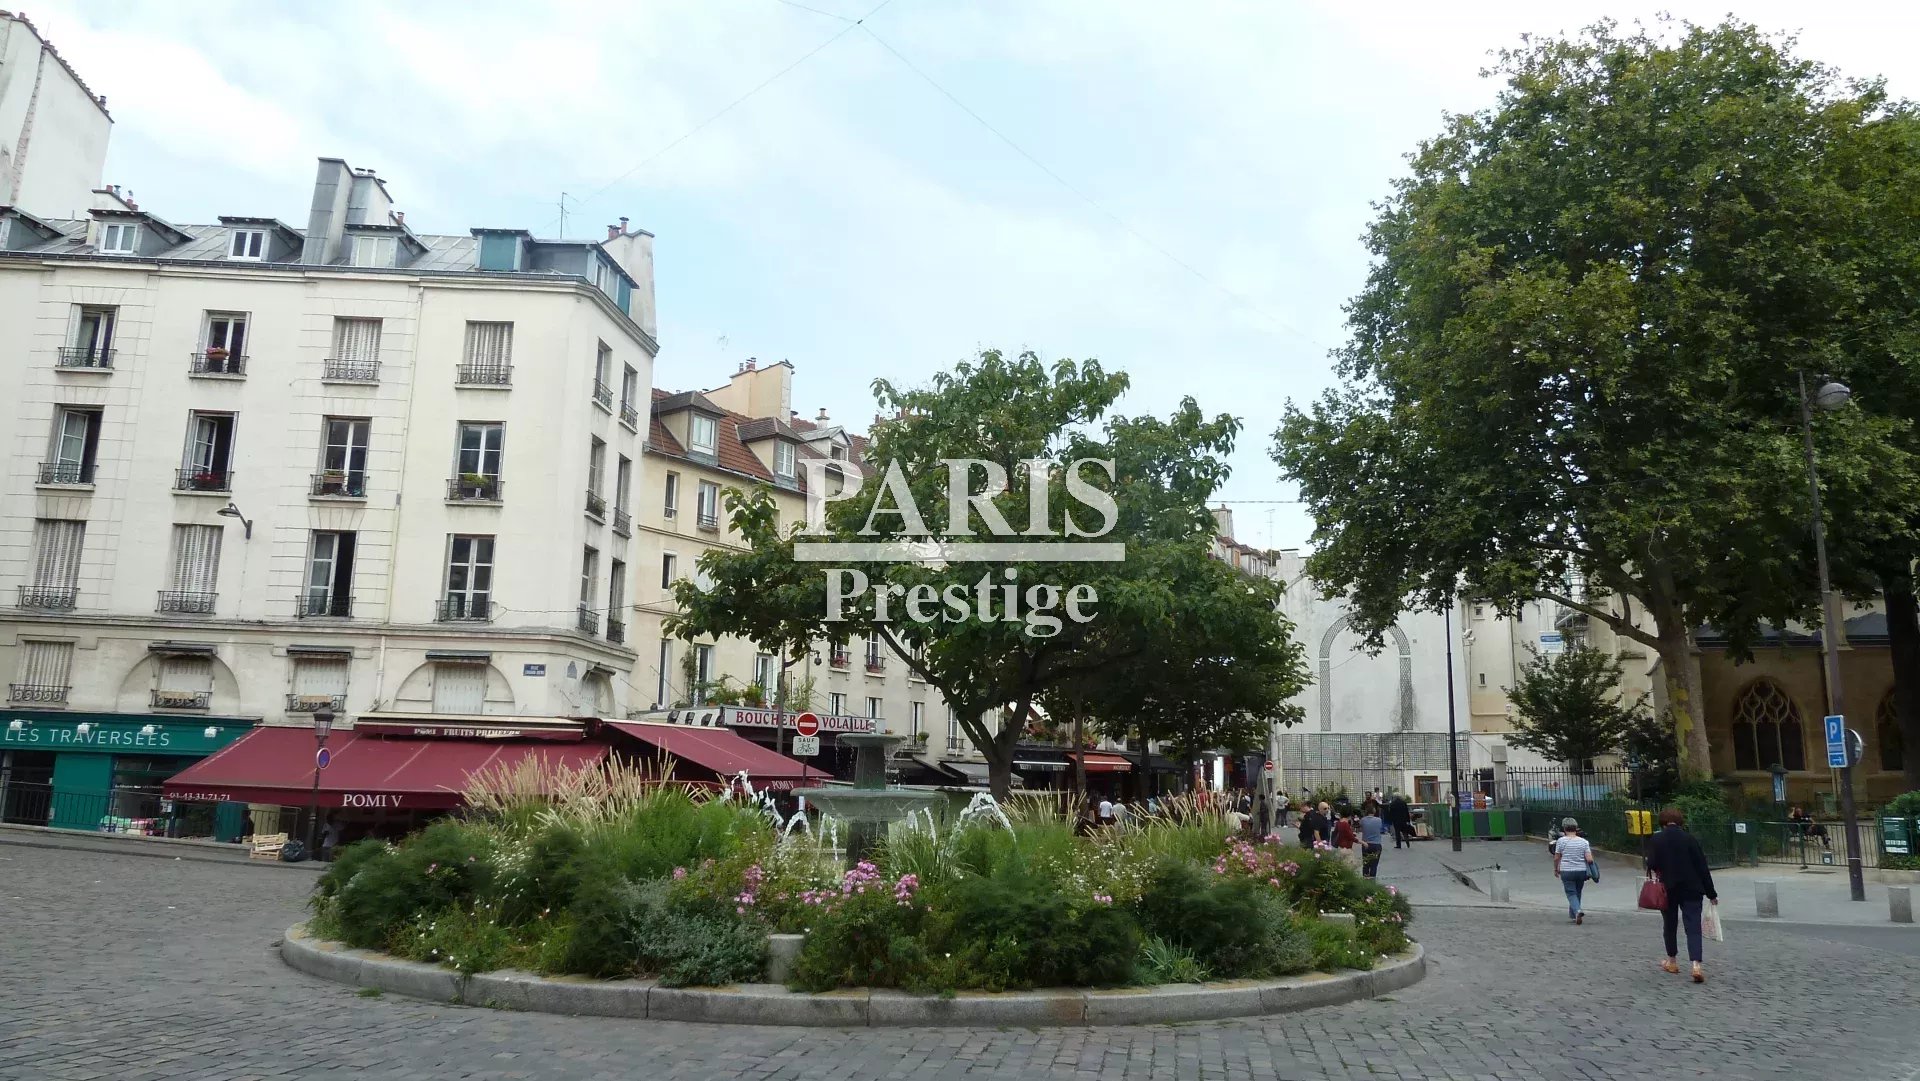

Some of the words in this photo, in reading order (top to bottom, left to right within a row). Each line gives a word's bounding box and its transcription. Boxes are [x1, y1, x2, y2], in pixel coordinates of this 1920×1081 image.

[5, 727, 40, 742] LES
[443, 728, 475, 736] FRUITS
[1829, 721, 1838, 739] P
[342, 793, 387, 807] POMI
[391, 795, 403, 807] V
